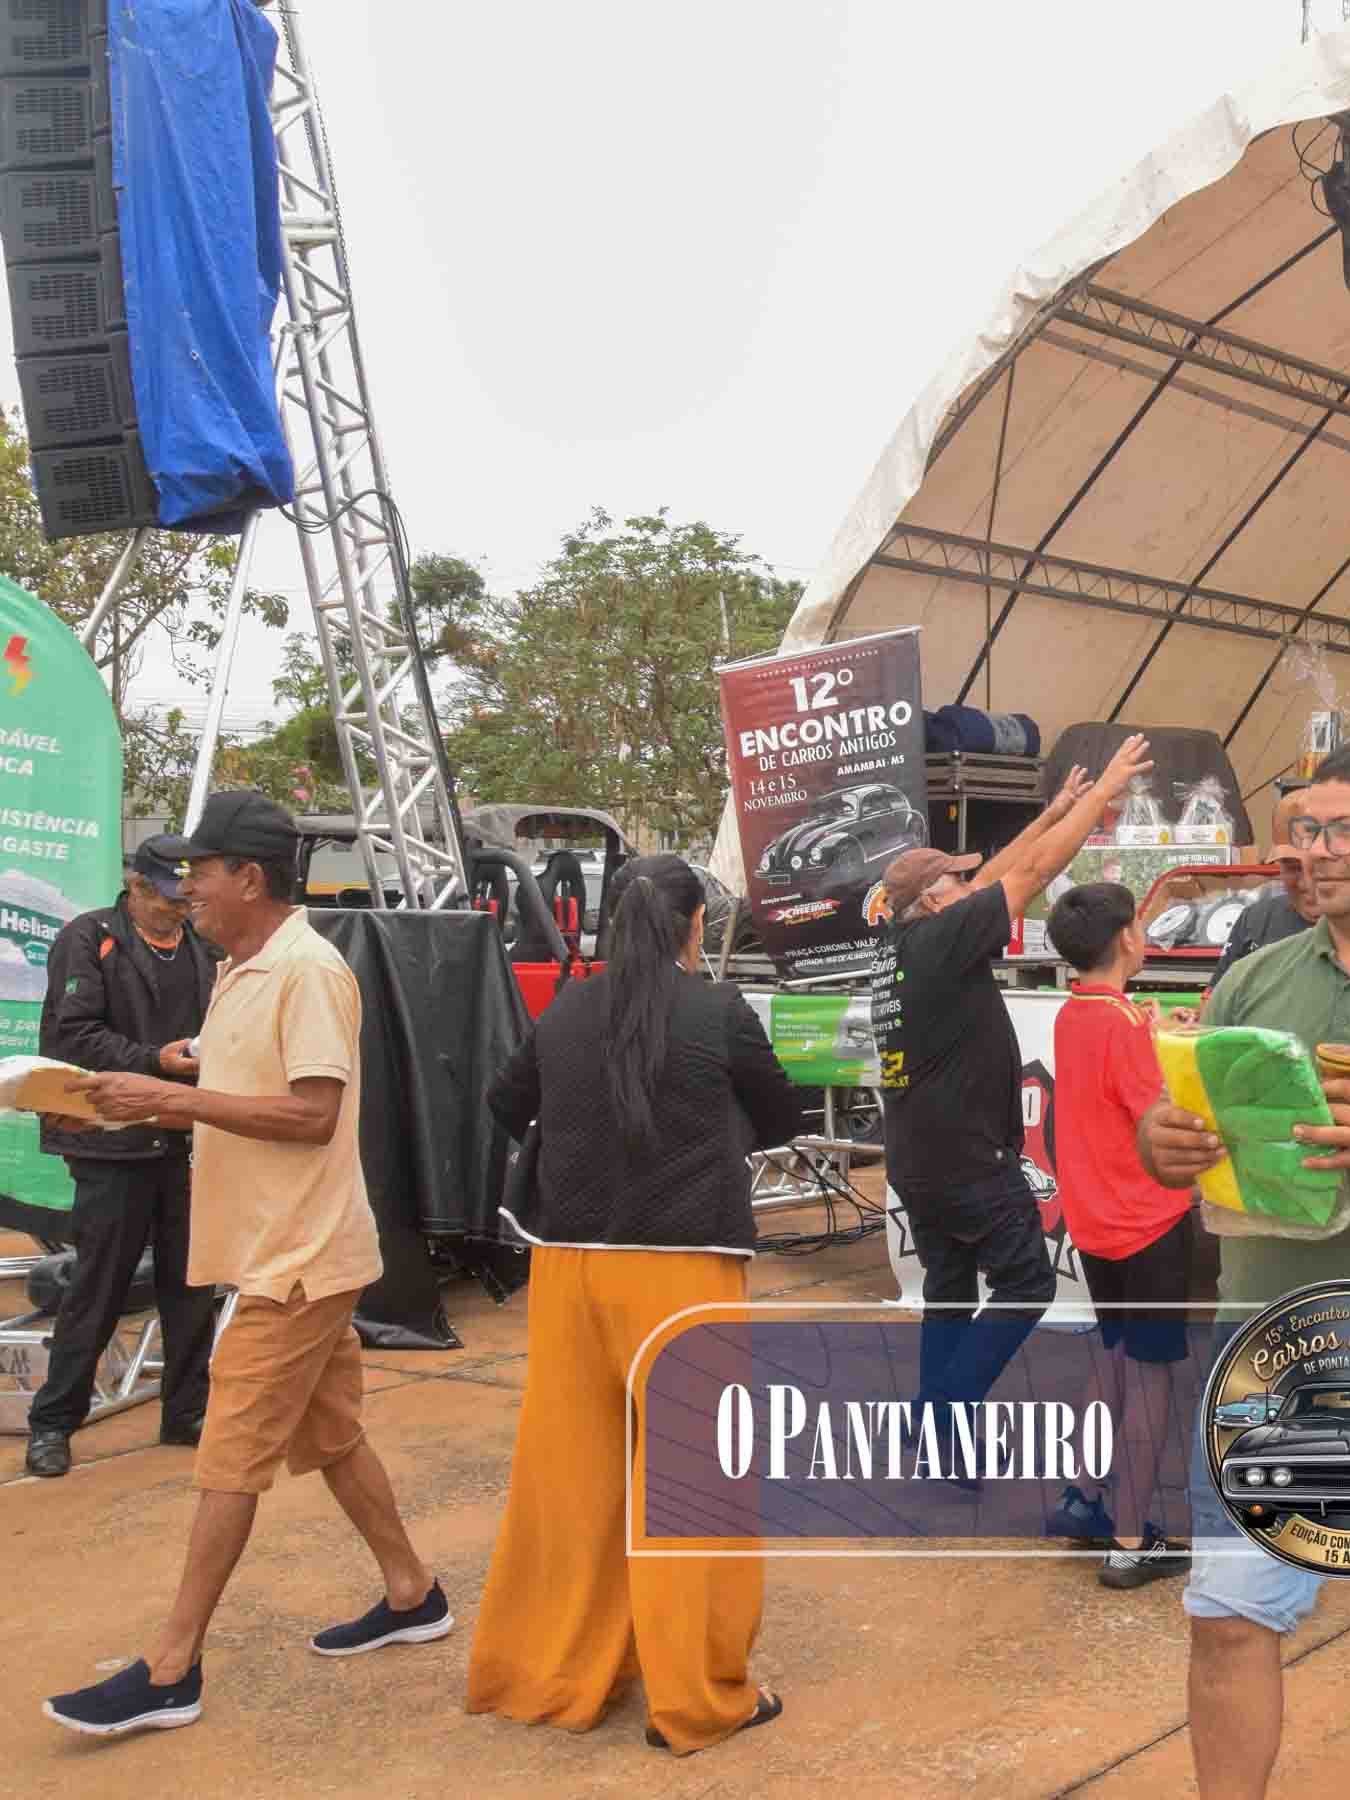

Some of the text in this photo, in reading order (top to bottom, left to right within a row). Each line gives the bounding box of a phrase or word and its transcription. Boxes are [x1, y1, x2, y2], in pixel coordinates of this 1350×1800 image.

[789, 668, 853, 712] 12º
[740, 701, 912, 758] ENCONTRO
[0, 757, 33, 775] CA
[760, 730, 896, 772] DE CARROS ANTIGOS
[751, 773, 796, 795] 14 e 15
[744, 789, 807, 812] NOVEMBRO
[0, 807, 99, 838] ISTÊNCIA
[1, 909, 59, 940] Heliar
[815, 942, 855, 953] CORONEL
